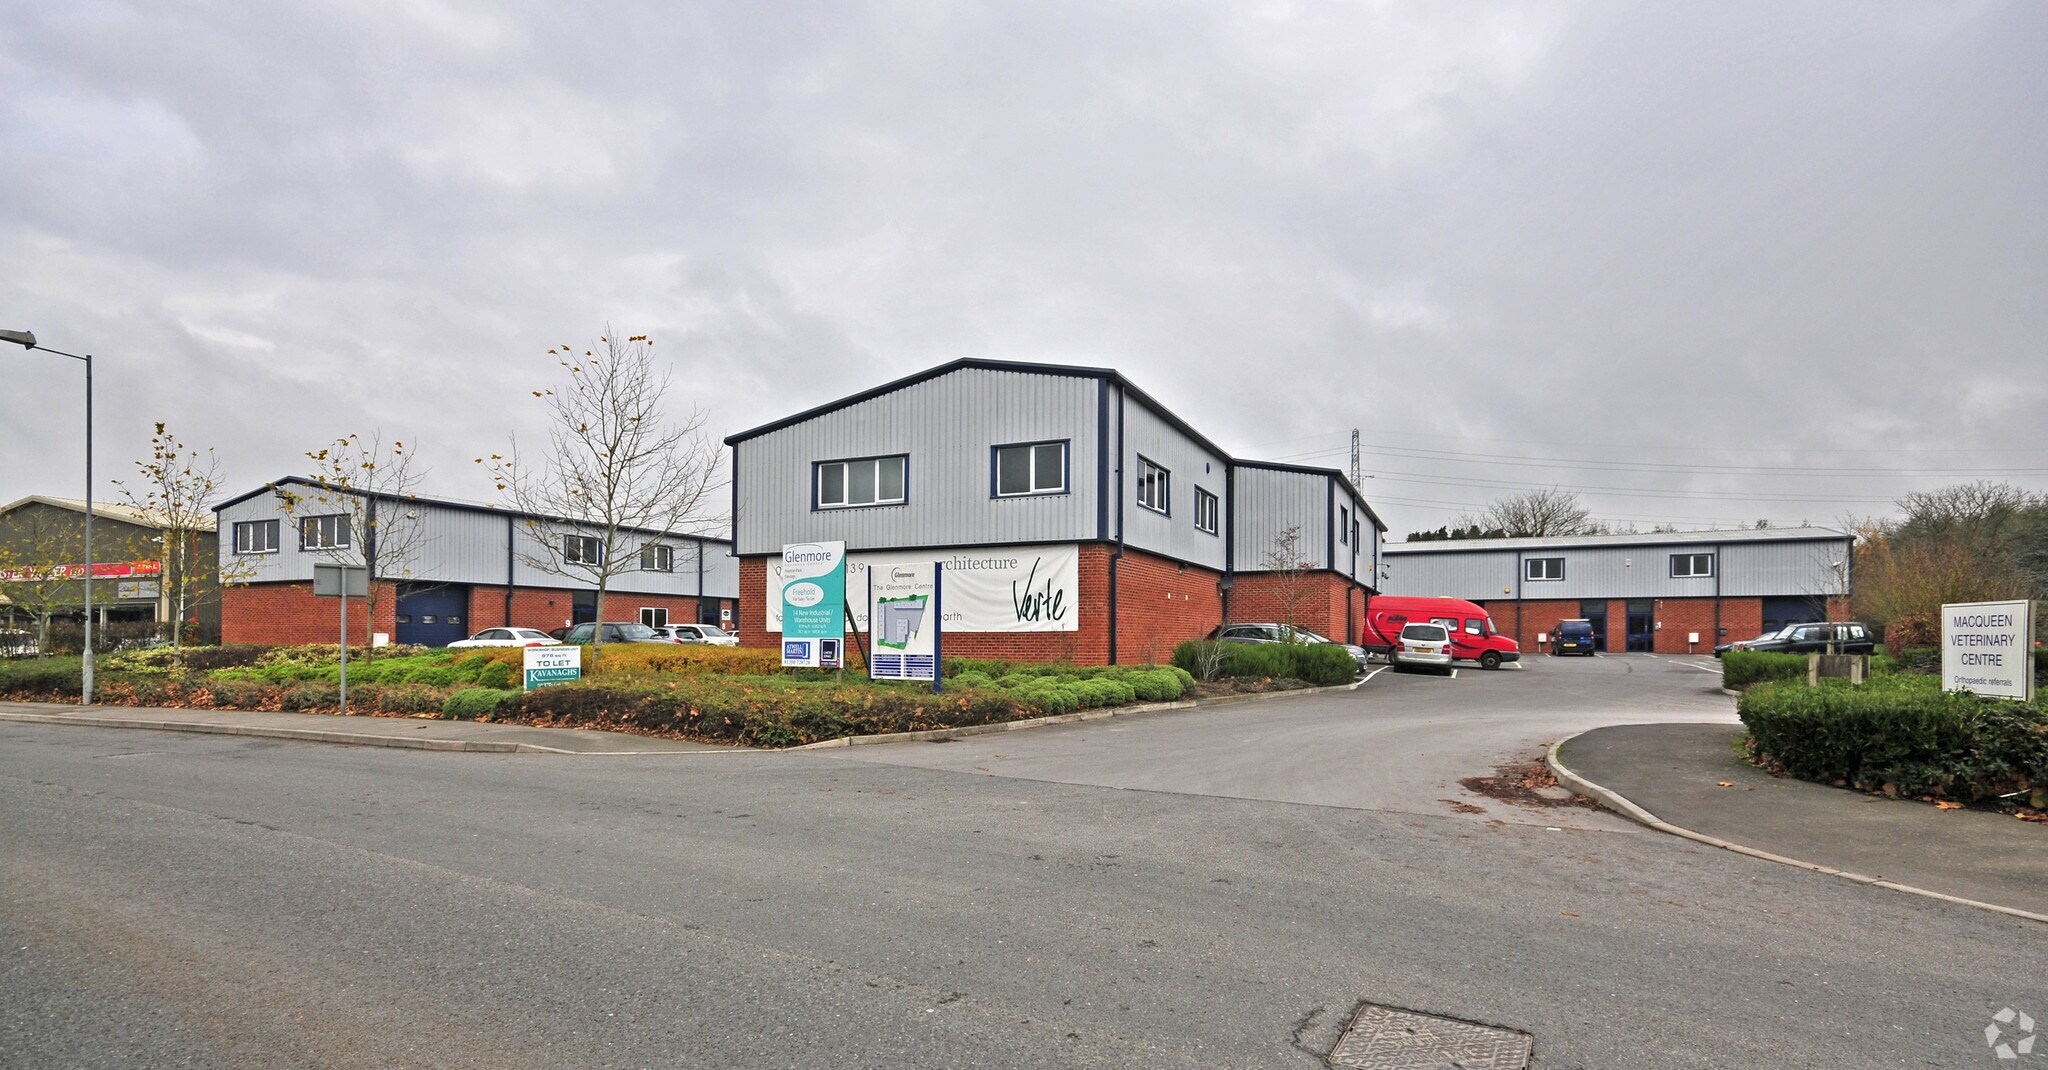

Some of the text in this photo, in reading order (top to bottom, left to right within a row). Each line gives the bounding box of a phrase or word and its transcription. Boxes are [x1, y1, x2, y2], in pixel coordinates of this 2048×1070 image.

[784, 550, 832, 563] Glenmore
[941, 555, 1018, 570] rchitecture
[1012, 556, 1066, 622] Verte
[942, 612, 962, 622] arth
[1954, 614, 2012, 627] MACQUEEN
[1951, 634, 2015, 646] VETERINARY
[1961, 653, 2002, 666] CENTRE
[530, 669, 577, 682] KAVANAGHS
[1954, 676, 2012, 686] Orthopaedic referrals
